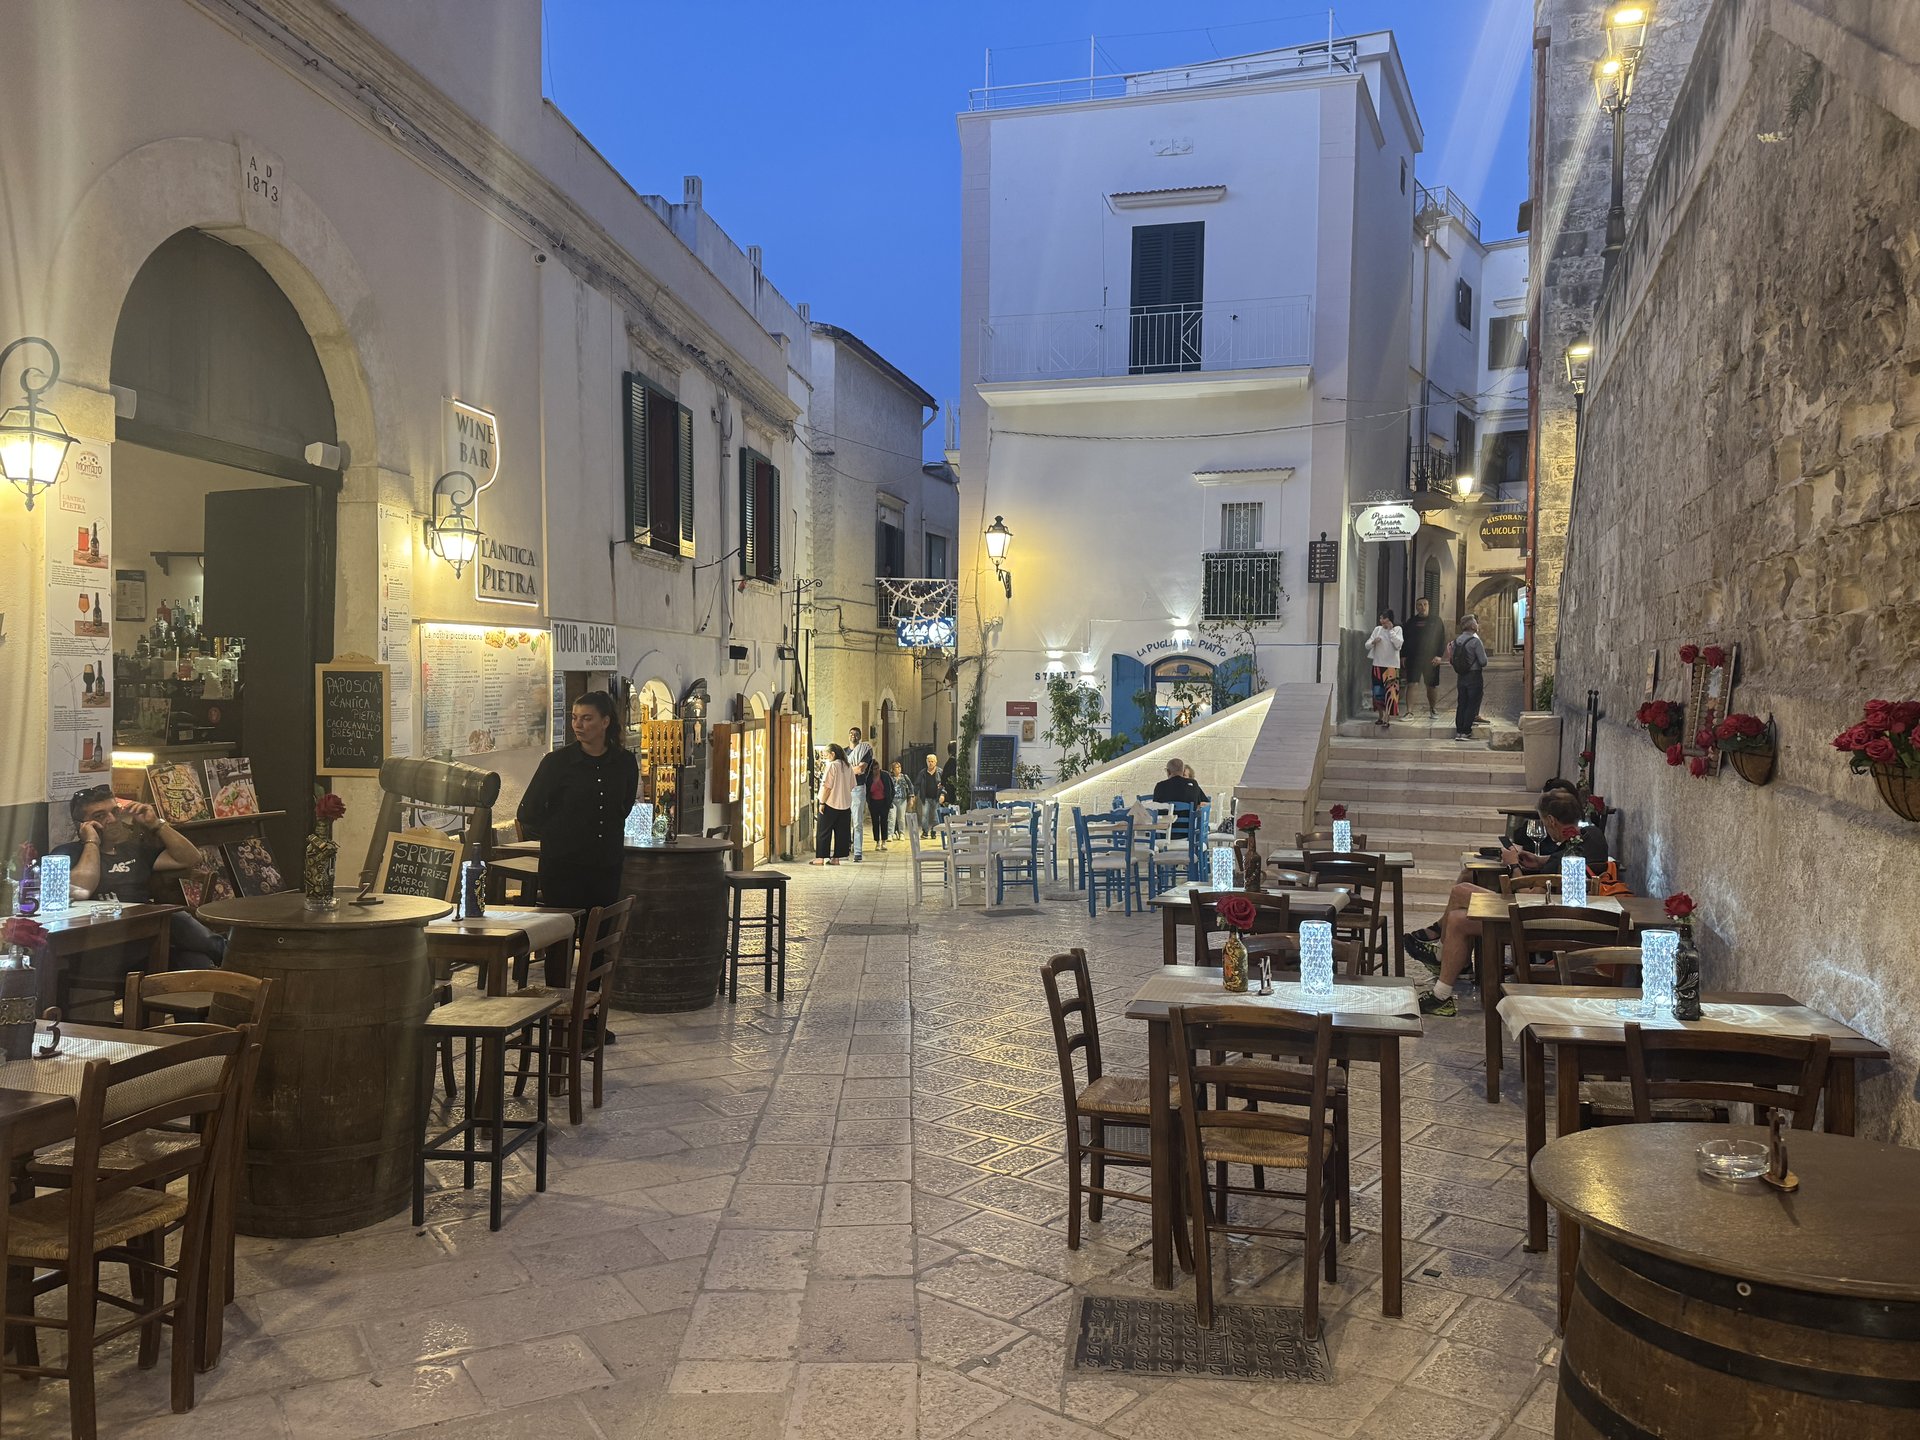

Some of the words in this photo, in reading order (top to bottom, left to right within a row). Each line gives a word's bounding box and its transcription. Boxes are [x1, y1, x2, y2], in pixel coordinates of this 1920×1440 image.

[249, 155, 258, 171] A
[265, 163, 273, 178] D
[246, 171, 279, 202] 1873
[455, 411, 496, 445] WINE
[458, 441, 491, 470] BAR
[1486, 513, 1528, 525] RISTORANT
[1491, 526, 1528, 536] VICOLETT
[480, 537, 537, 567] L'ANTICA
[481, 563, 537, 596] PIETRA
[553, 623, 579, 653] TOUR
[580, 632, 588, 653] IN
[588, 625, 616, 655] BARCA
[1199, 639, 1227, 657] PIATTO
[1046, 682, 1074, 691] FD
[394, 876, 429, 889] APEROL
[40, 1006, 62, 1054] 3
